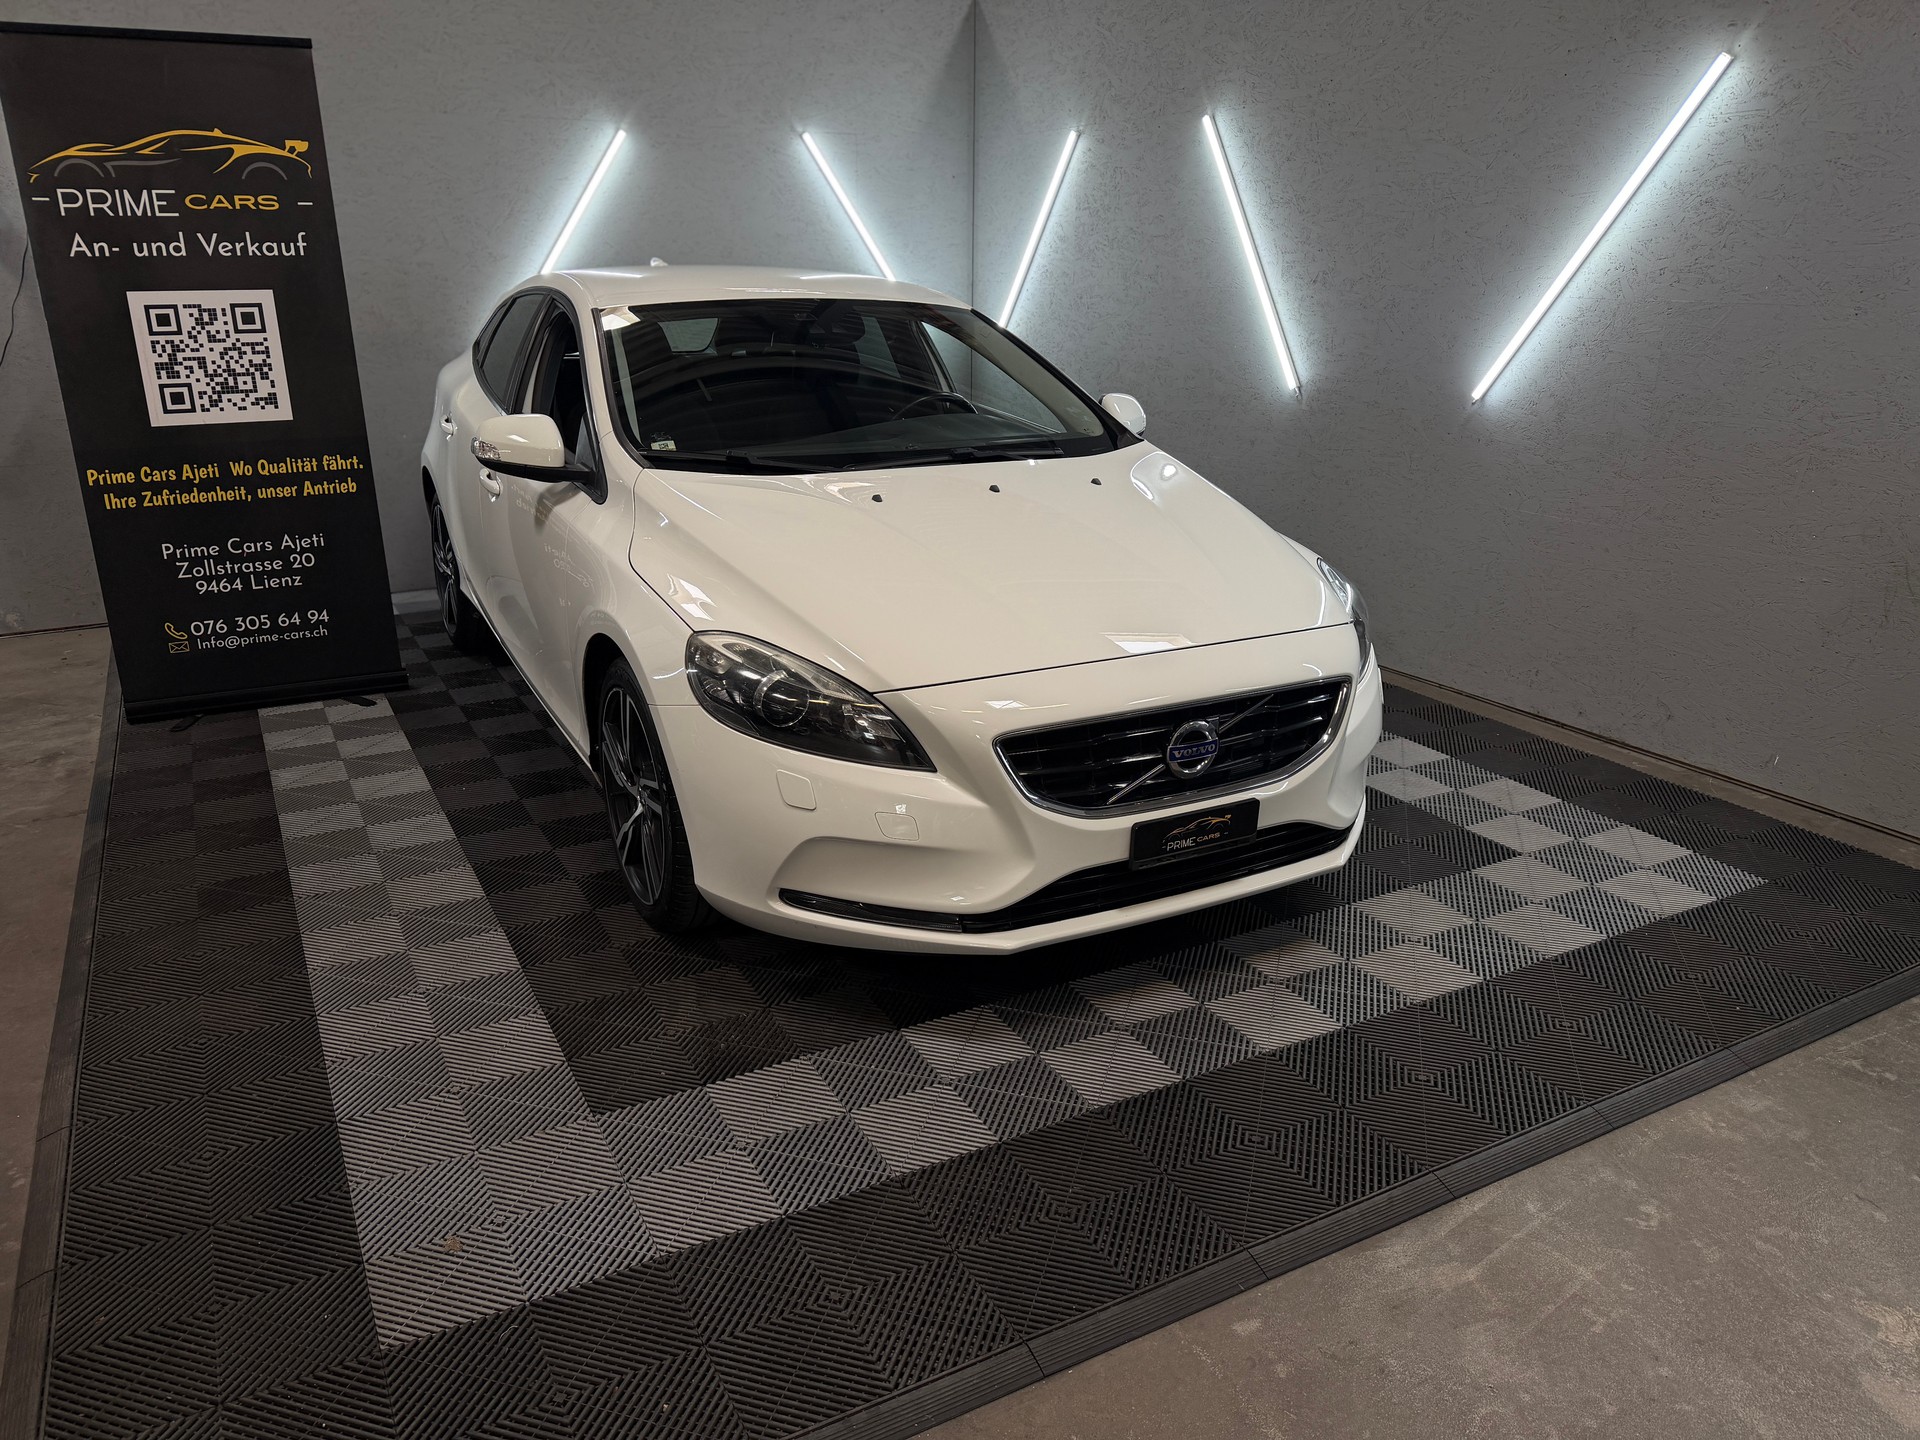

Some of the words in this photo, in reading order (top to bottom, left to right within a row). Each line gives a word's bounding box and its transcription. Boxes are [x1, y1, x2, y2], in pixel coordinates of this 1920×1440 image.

[57, 189, 179, 216] PRIME
[185, 195, 279, 210] CARS
[70, 233, 119, 257] An-
[133, 232, 186, 256] und
[197, 232, 306, 256] Verkauf
[87, 470, 135, 485] Prime
[141, 467, 176, 482] Cars
[182, 463, 219, 483] Ajeti
[229, 461, 252, 476] Wo
[258, 458, 317, 475] Qualität
[323, 455, 363, 470] fährt.
[104, 493, 136, 509] Ihre
[142, 486, 251, 506] Zufriedenheit,
[258, 486, 297, 498] unser
[304, 478, 356, 496] Antrieb
[162, 544, 219, 559] Prime
[228, 538, 272, 554] Cars
[281, 534, 324, 551] Ajeti
[176, 558, 283, 579] Zollstrasse
[290, 553, 314, 568] 20
[196, 578, 243, 594] 9464
[251, 575, 302, 589] Lienz
[191, 620, 227, 635] 076
[235, 615, 270, 631] 305
[278, 612, 300, 626] 64
[308, 609, 329, 623] 94
[197, 626, 328, 649] Info@prime-cars.ch
[1172, 743, 1216, 758] VOLVO
[1167, 837, 1196, 851] PRIME
[1197, 832, 1220, 842] CARS
